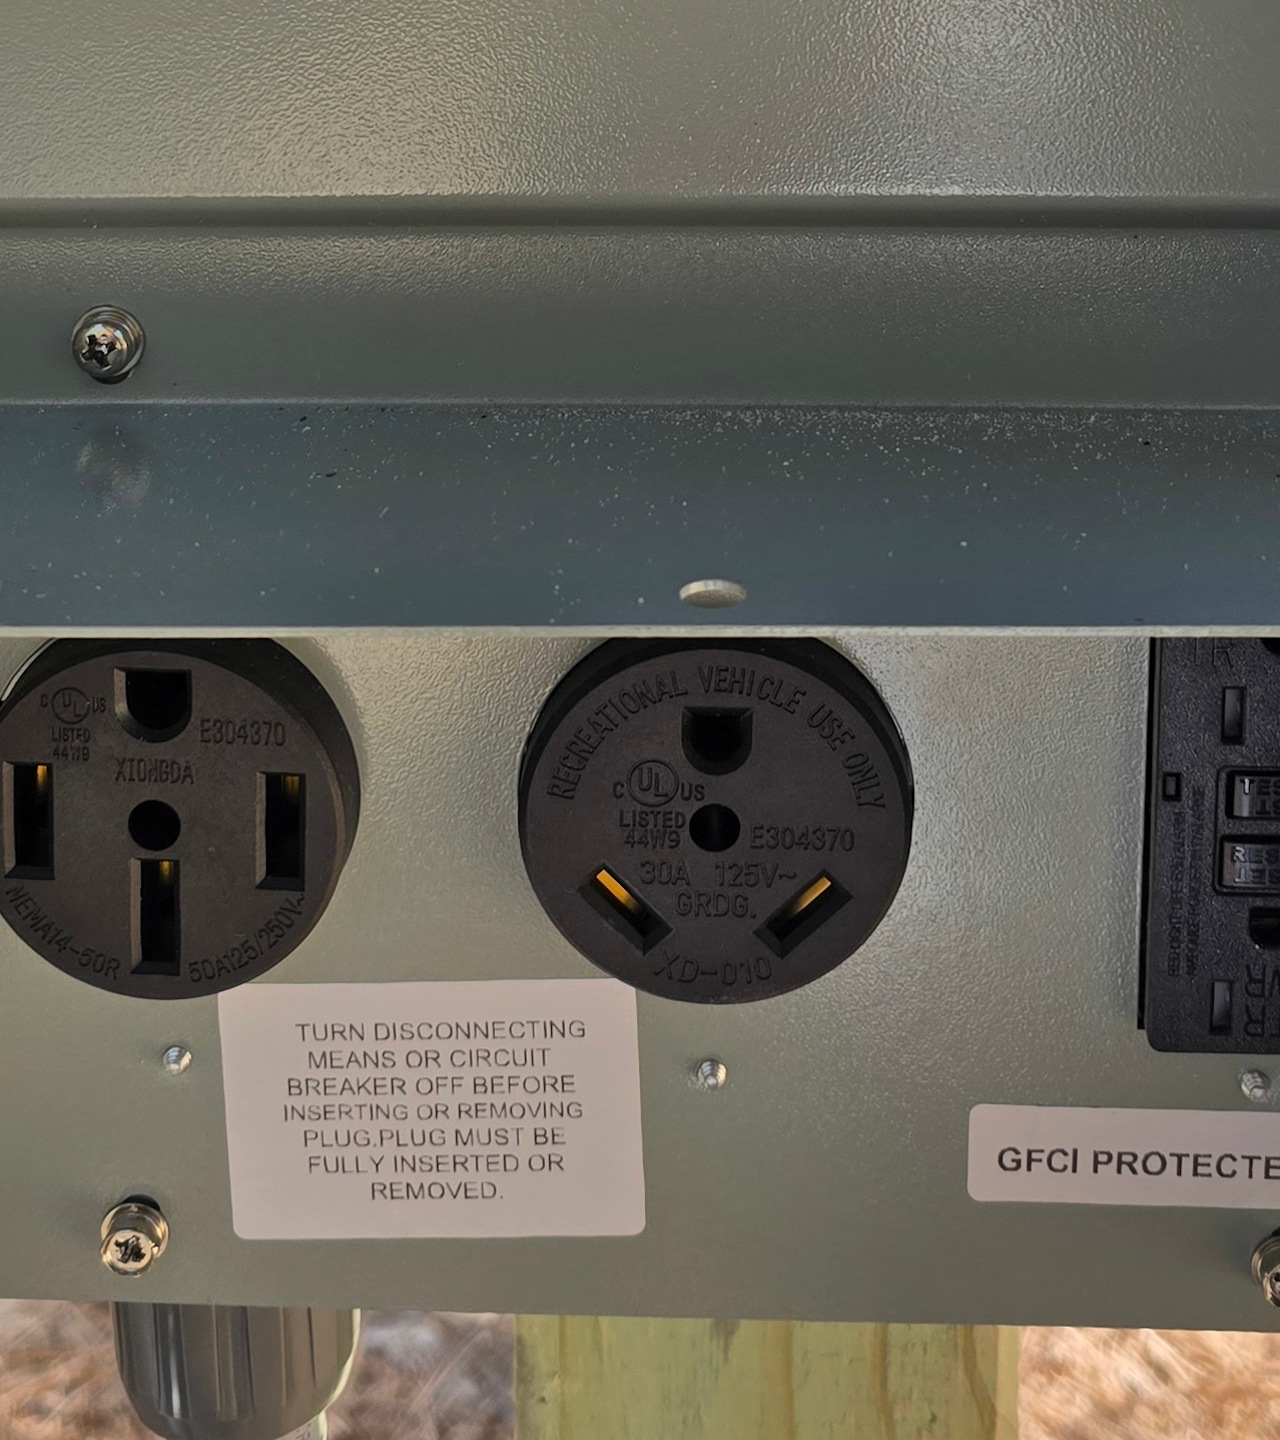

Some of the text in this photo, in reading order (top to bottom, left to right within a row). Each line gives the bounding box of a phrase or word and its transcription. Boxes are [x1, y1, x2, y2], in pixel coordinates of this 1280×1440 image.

[52, 727, 91, 743] LISTED
[199, 718, 286, 747] E304370
[547, 665, 886, 810] RECREATIONAL VEHICLE USE ONLY
[115, 758, 194, 784] XIONGDA
[638, 768, 669, 797] UL
[681, 783, 705, 801] US
[620, 810, 686, 830] LISTED
[624, 830, 681, 849] 44W9
[750, 825, 855, 852] E304370
[640, 861, 690, 886] 30A
[676, 893, 757, 919] GRDG.
[654, 950, 773, 985] XD-010
[295, 1020, 585, 1042] TURN DISCONNECTING
[309, 1048, 550, 1069] MEANS OR CIRCUIT
[288, 1075, 574, 1096] BREAKER OFF BEFORE
[284, 1102, 582, 1121] INSERTING OR REMOVING
[304, 1128, 565, 1147] PLUG.PLUG MUST BE
[309, 1154, 564, 1173] FULLY INSERTED OR
[998, 1147, 1078, 1173] GFCI
[372, 1182, 504, 1200] REMOVED.
